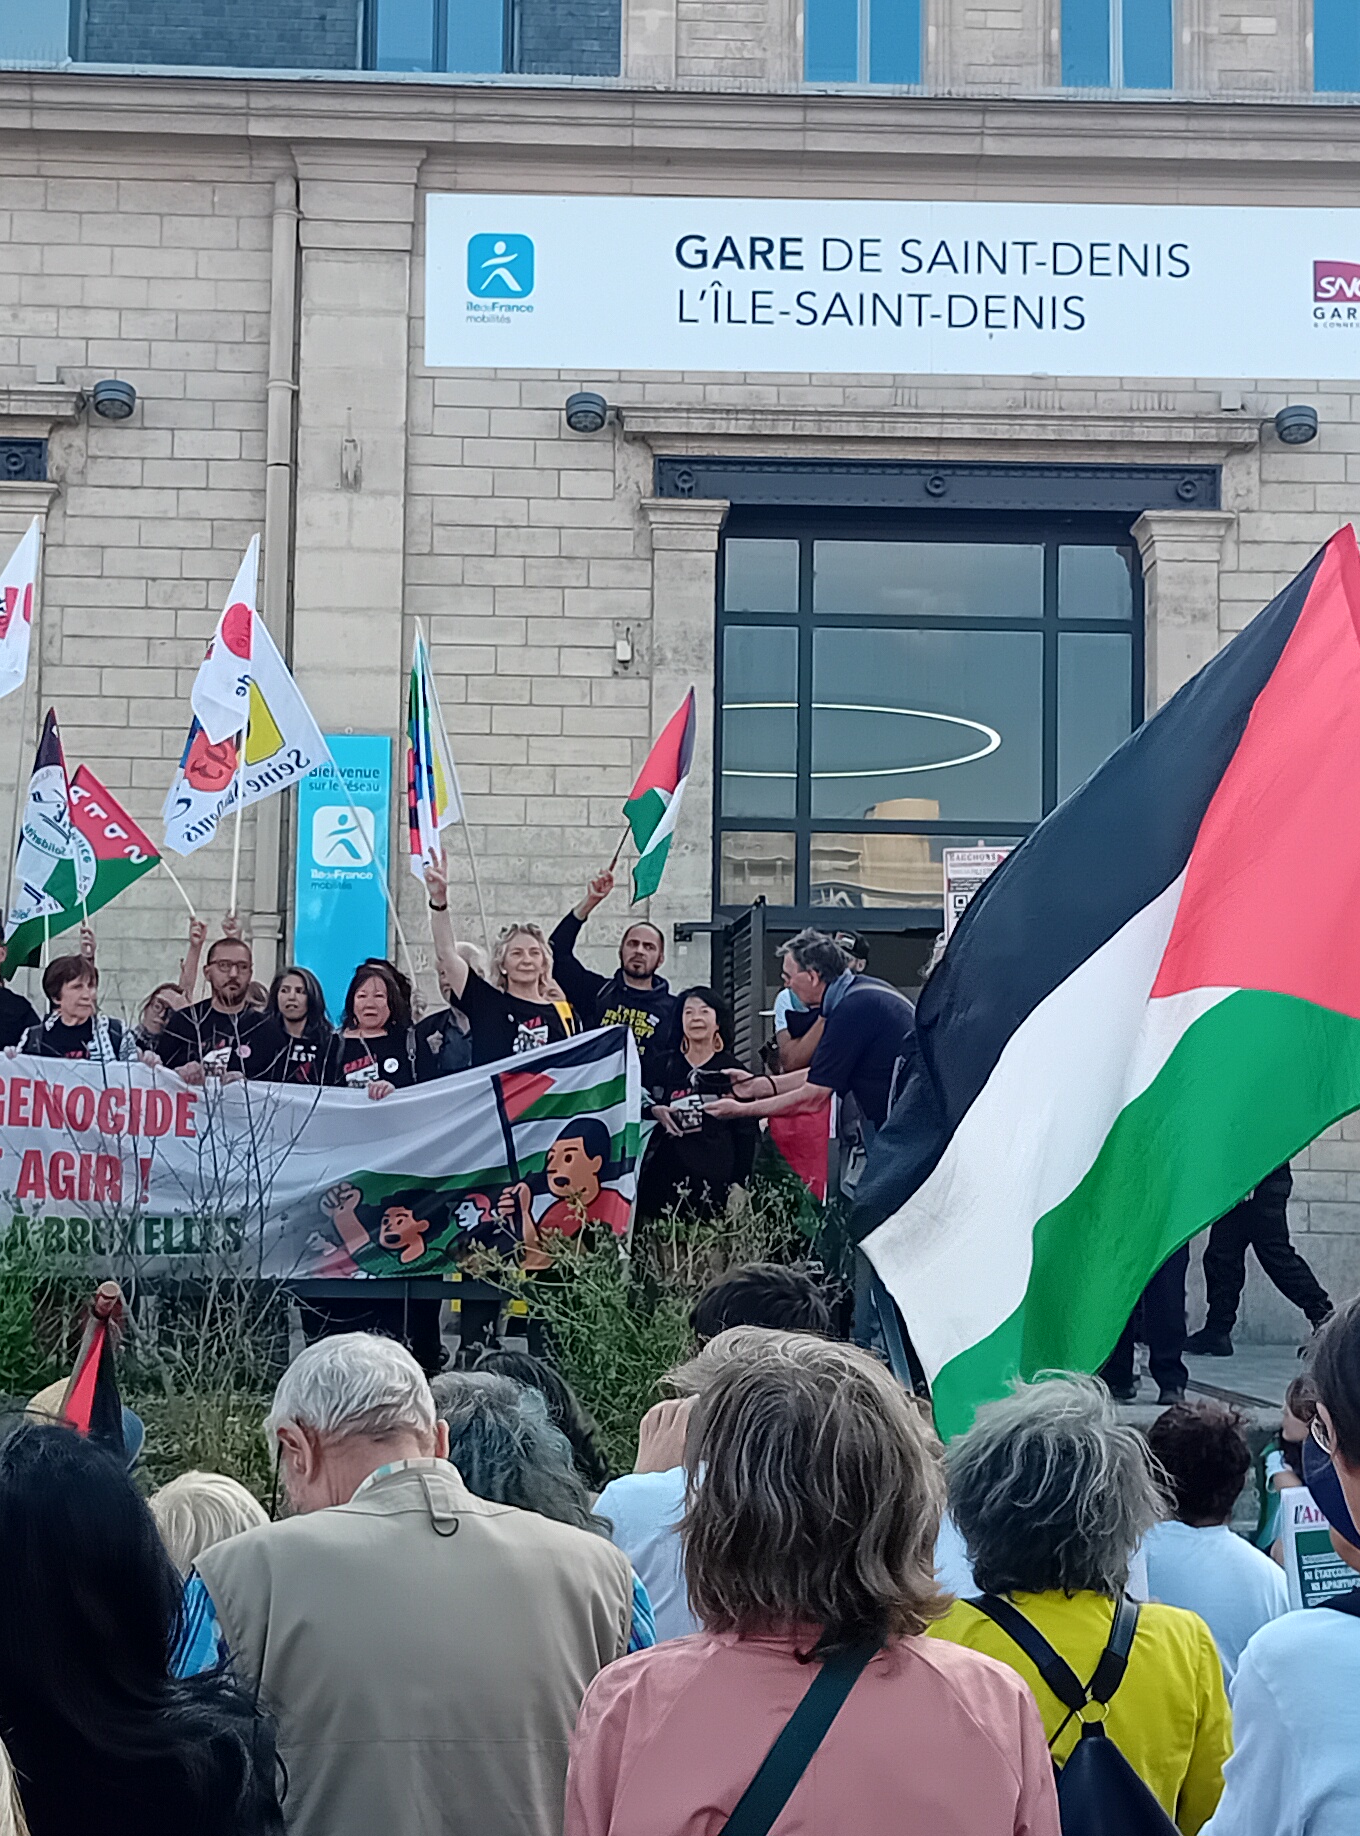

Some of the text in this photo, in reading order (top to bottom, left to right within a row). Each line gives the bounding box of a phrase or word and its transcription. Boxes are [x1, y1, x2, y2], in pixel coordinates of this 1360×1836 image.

[675, 234, 1190, 278] GARE DE SAINT-DENIS
[308, 782, 325, 792] sur
[329, 780, 339, 791] le
[16, 1149, 123, 1202] AGIR
